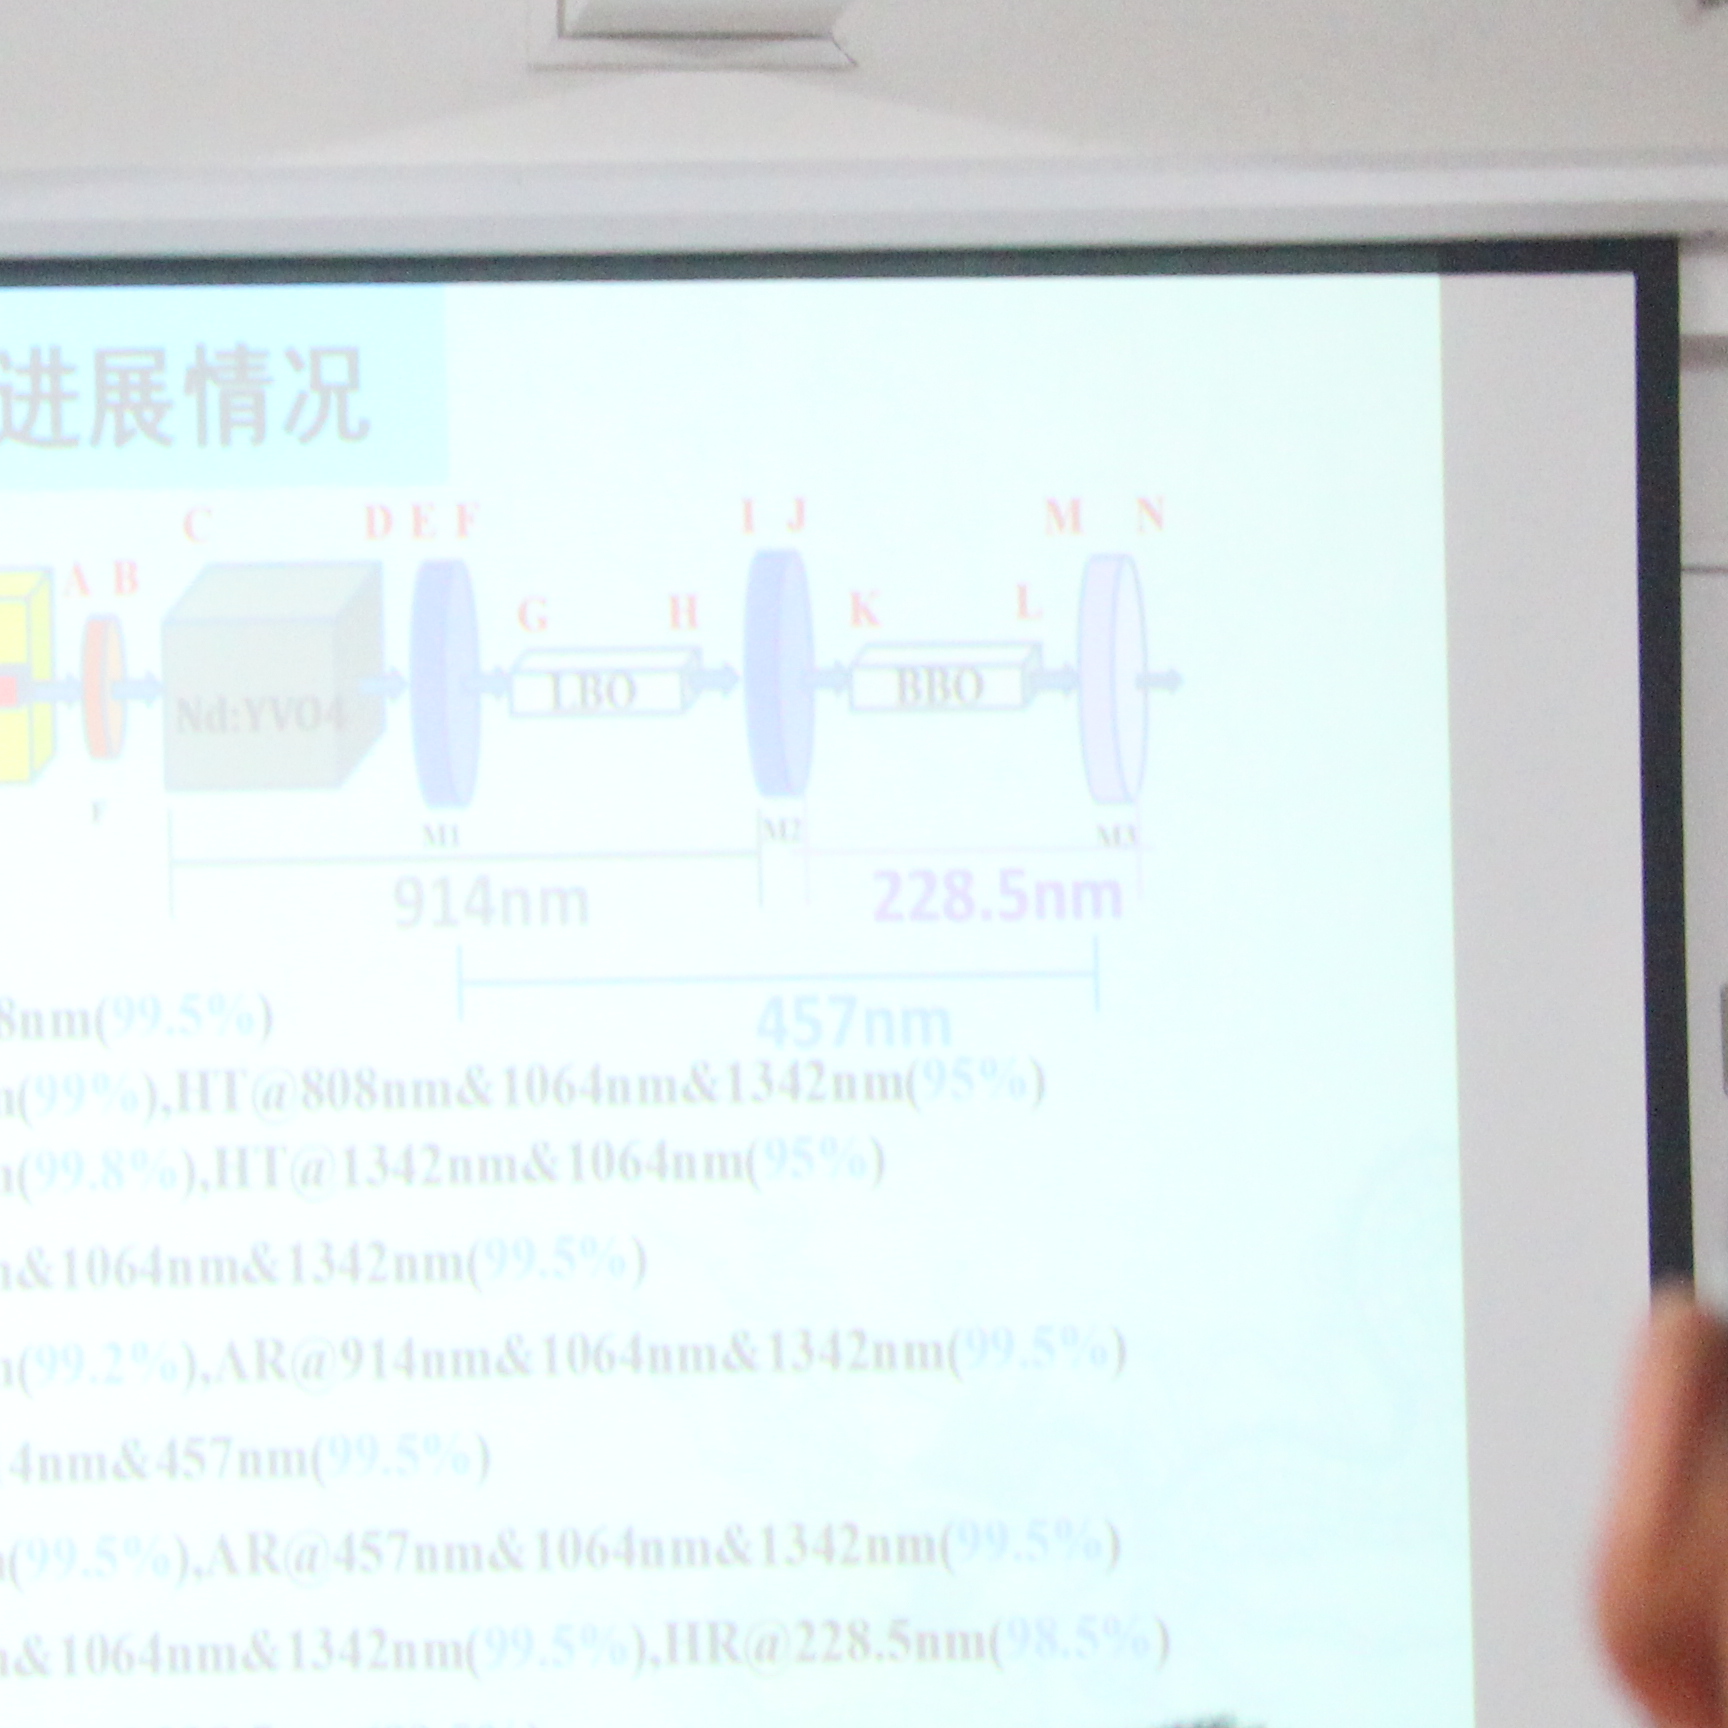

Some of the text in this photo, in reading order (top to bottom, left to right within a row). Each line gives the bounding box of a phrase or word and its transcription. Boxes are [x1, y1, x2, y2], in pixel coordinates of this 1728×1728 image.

[392, 873, 590, 930] 914nm
[872, 867, 1124, 925] 228.5nm
[755, 993, 953, 1050] 457nm
